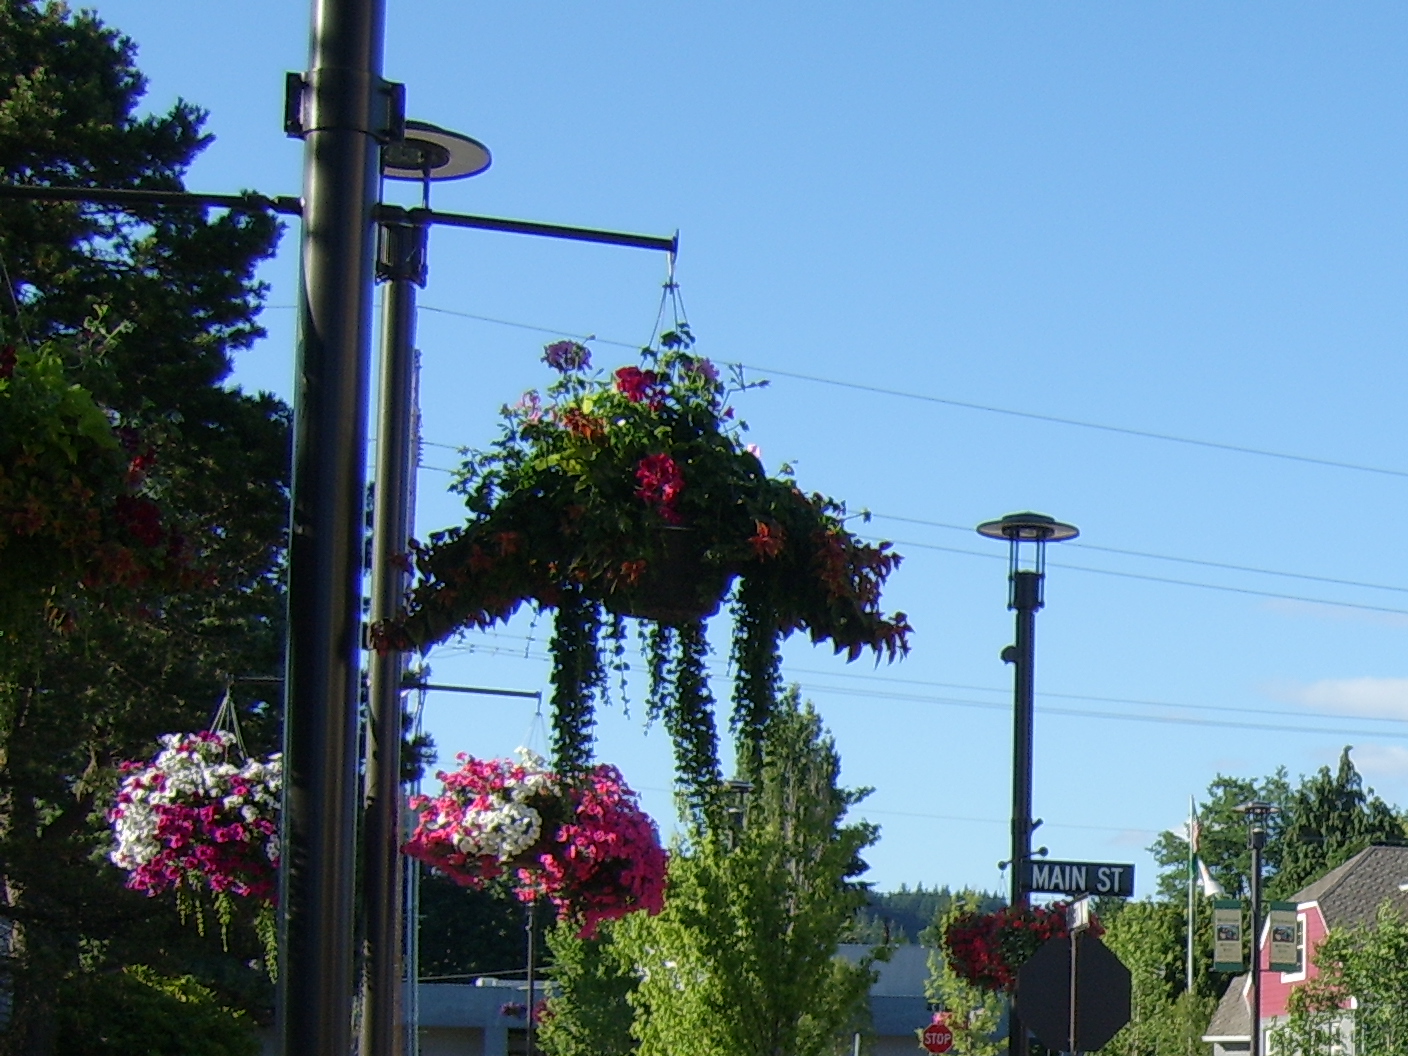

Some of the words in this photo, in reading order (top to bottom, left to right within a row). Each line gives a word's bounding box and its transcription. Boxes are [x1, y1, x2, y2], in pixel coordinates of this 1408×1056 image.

[1032, 864, 1087, 891] MAIN
[1096, 866, 1124, 893] ST
[924, 1032, 951, 1045] STOP
